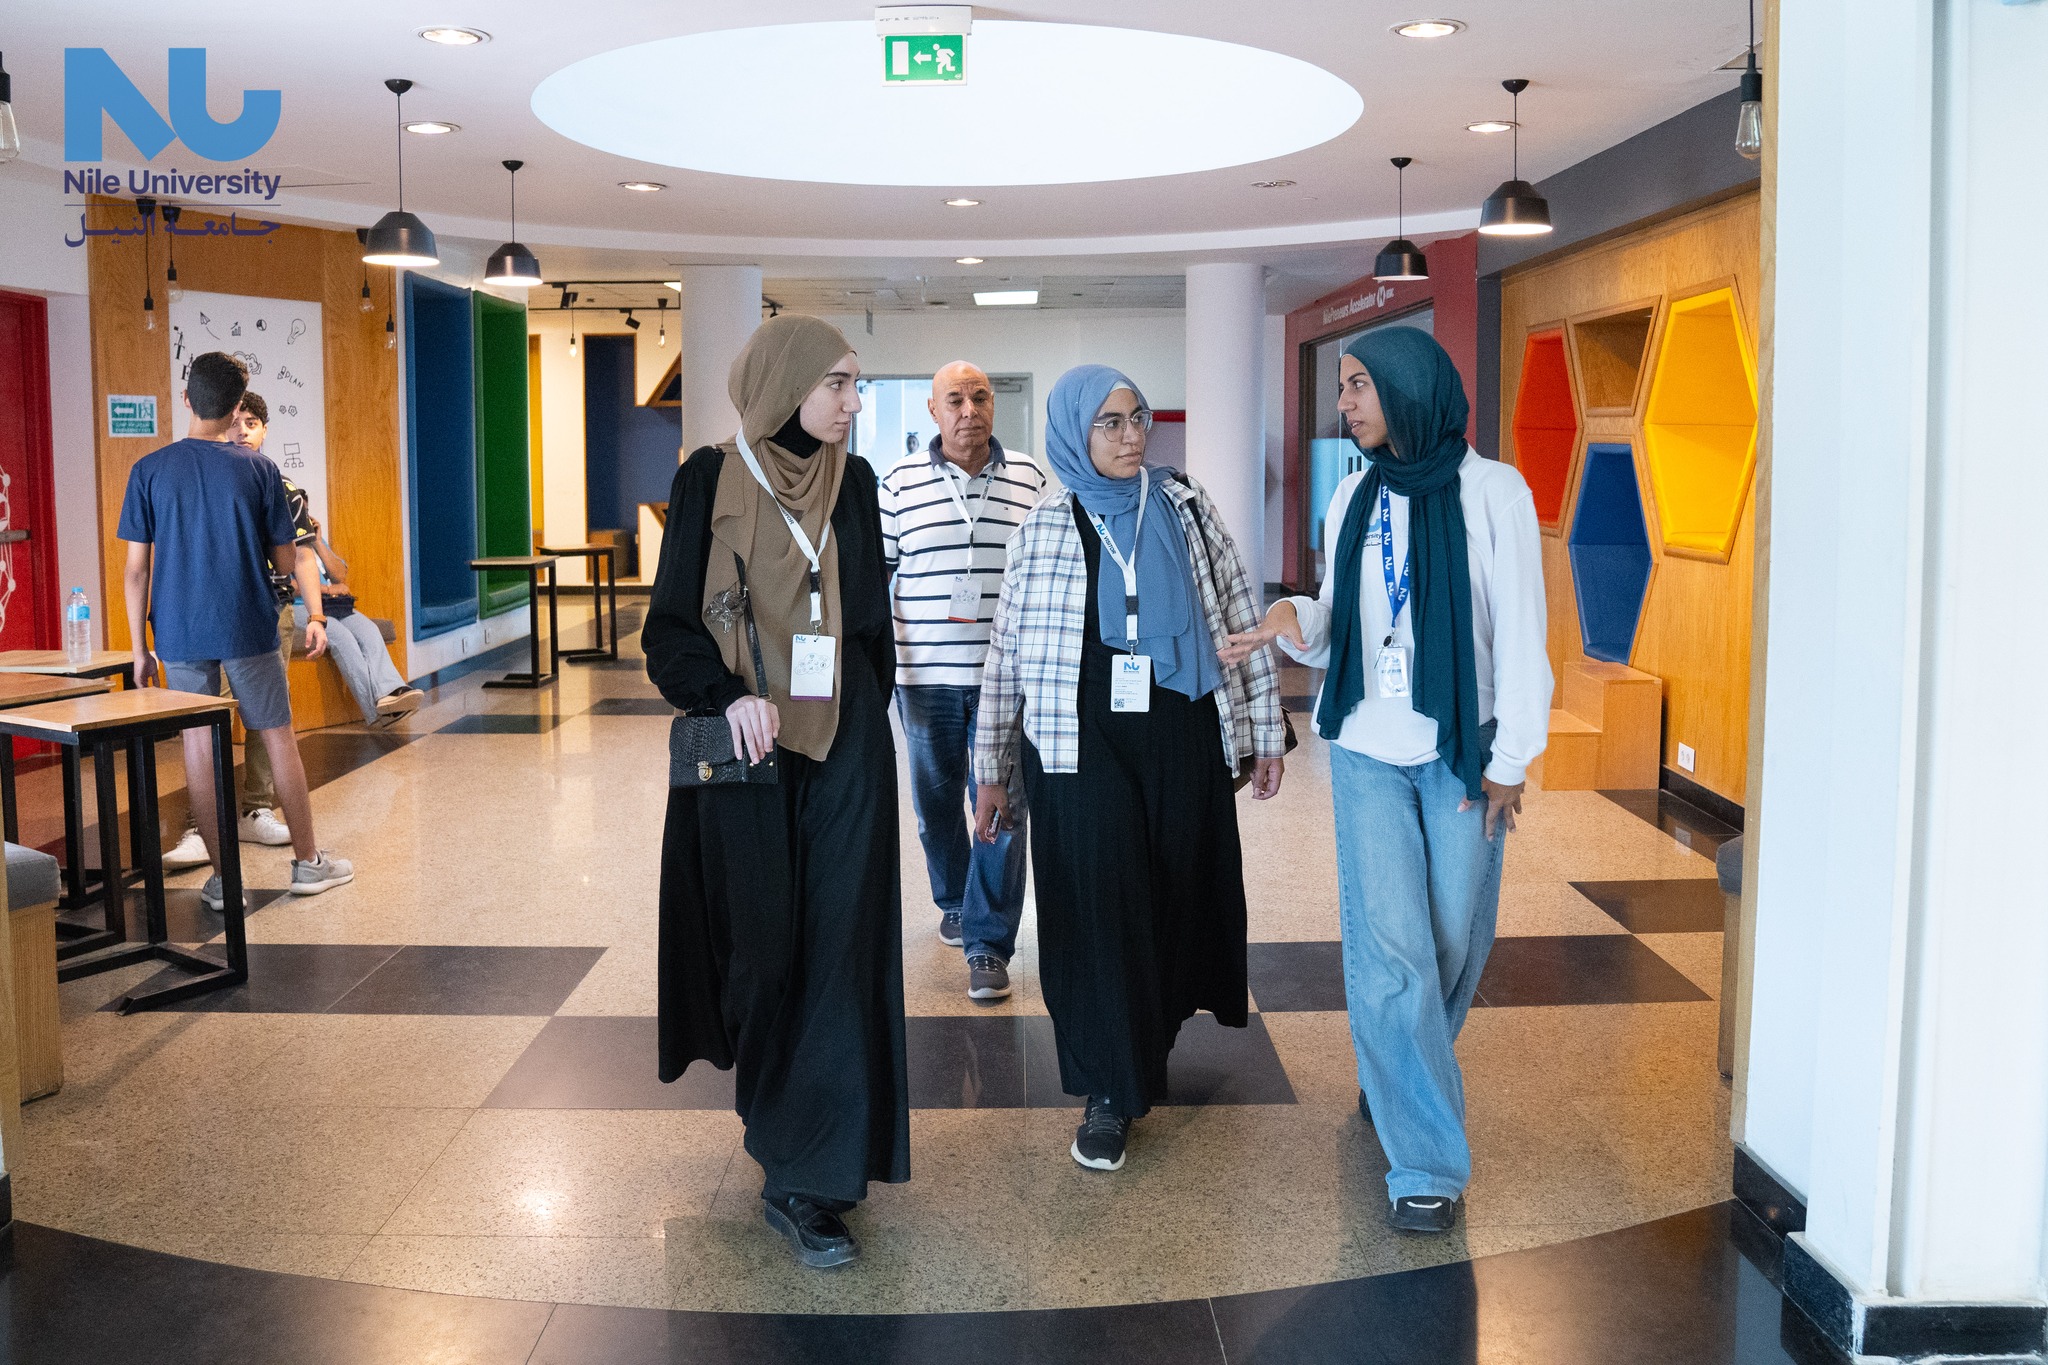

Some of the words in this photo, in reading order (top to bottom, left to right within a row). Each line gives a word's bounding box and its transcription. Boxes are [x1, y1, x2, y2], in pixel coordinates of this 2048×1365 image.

[284, 371, 305, 389] PLAN
[1104, 536, 1117, 555] VISITOR
[1123, 661, 1140, 671] NU
